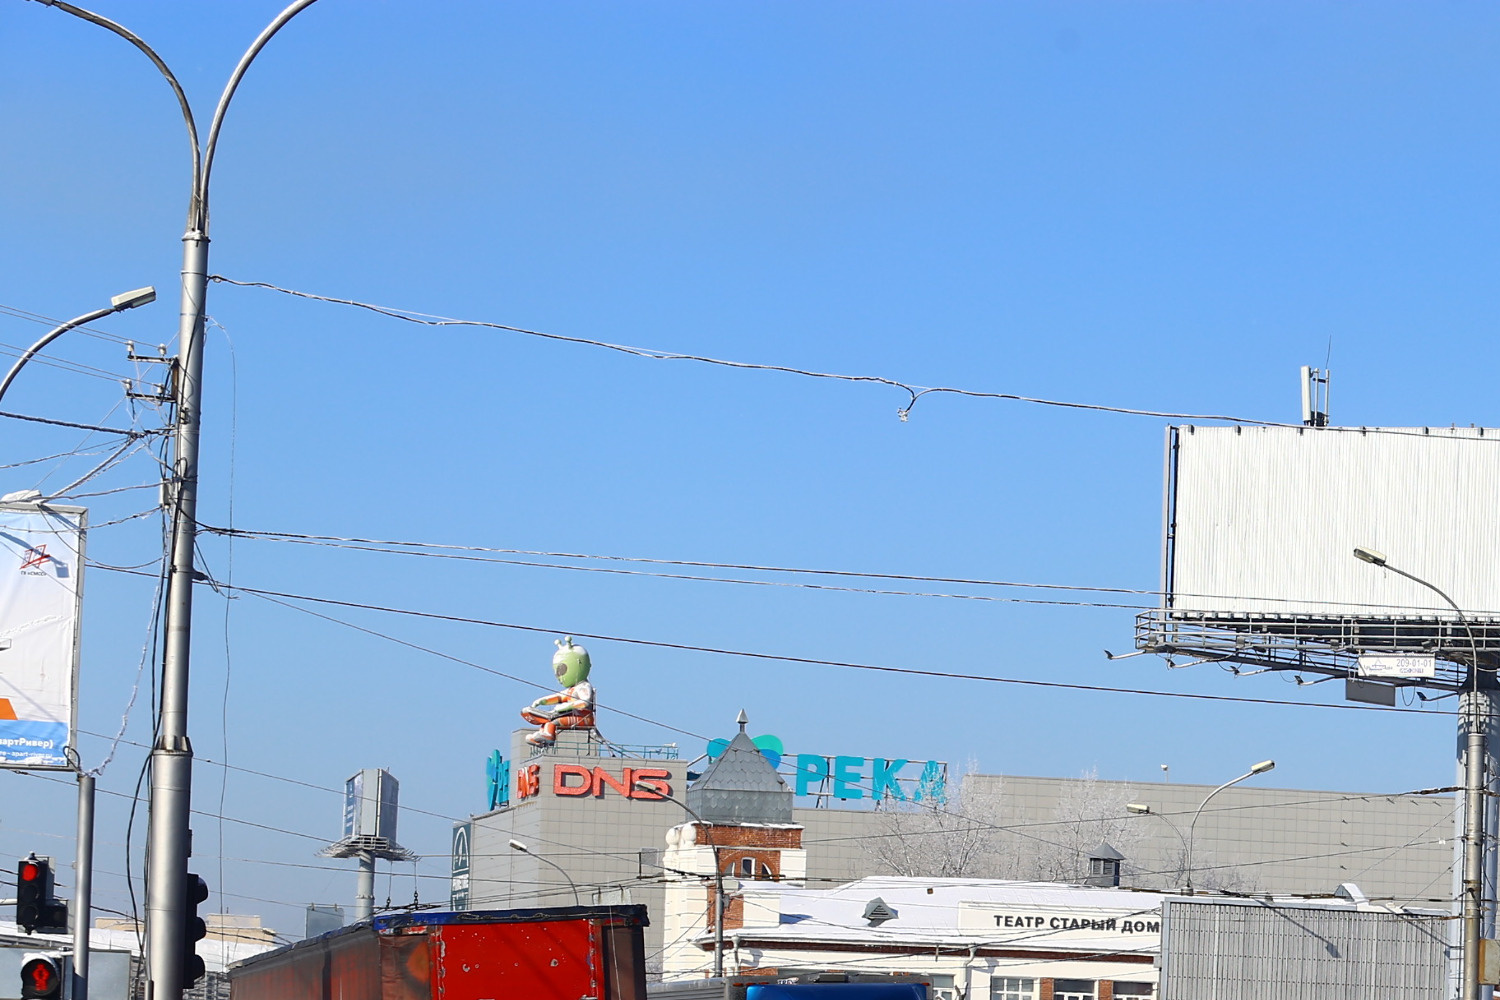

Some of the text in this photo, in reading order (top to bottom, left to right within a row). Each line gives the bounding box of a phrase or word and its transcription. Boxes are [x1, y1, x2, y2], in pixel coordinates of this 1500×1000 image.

[1396, 658, 1432, 667] 209-01-01
[552, 763, 670, 800] DNS
[795, 753, 946, 803] РЕКА
[993, 914, 1160, 934] ТЕАТР СТАРЫЙ ДОМ
